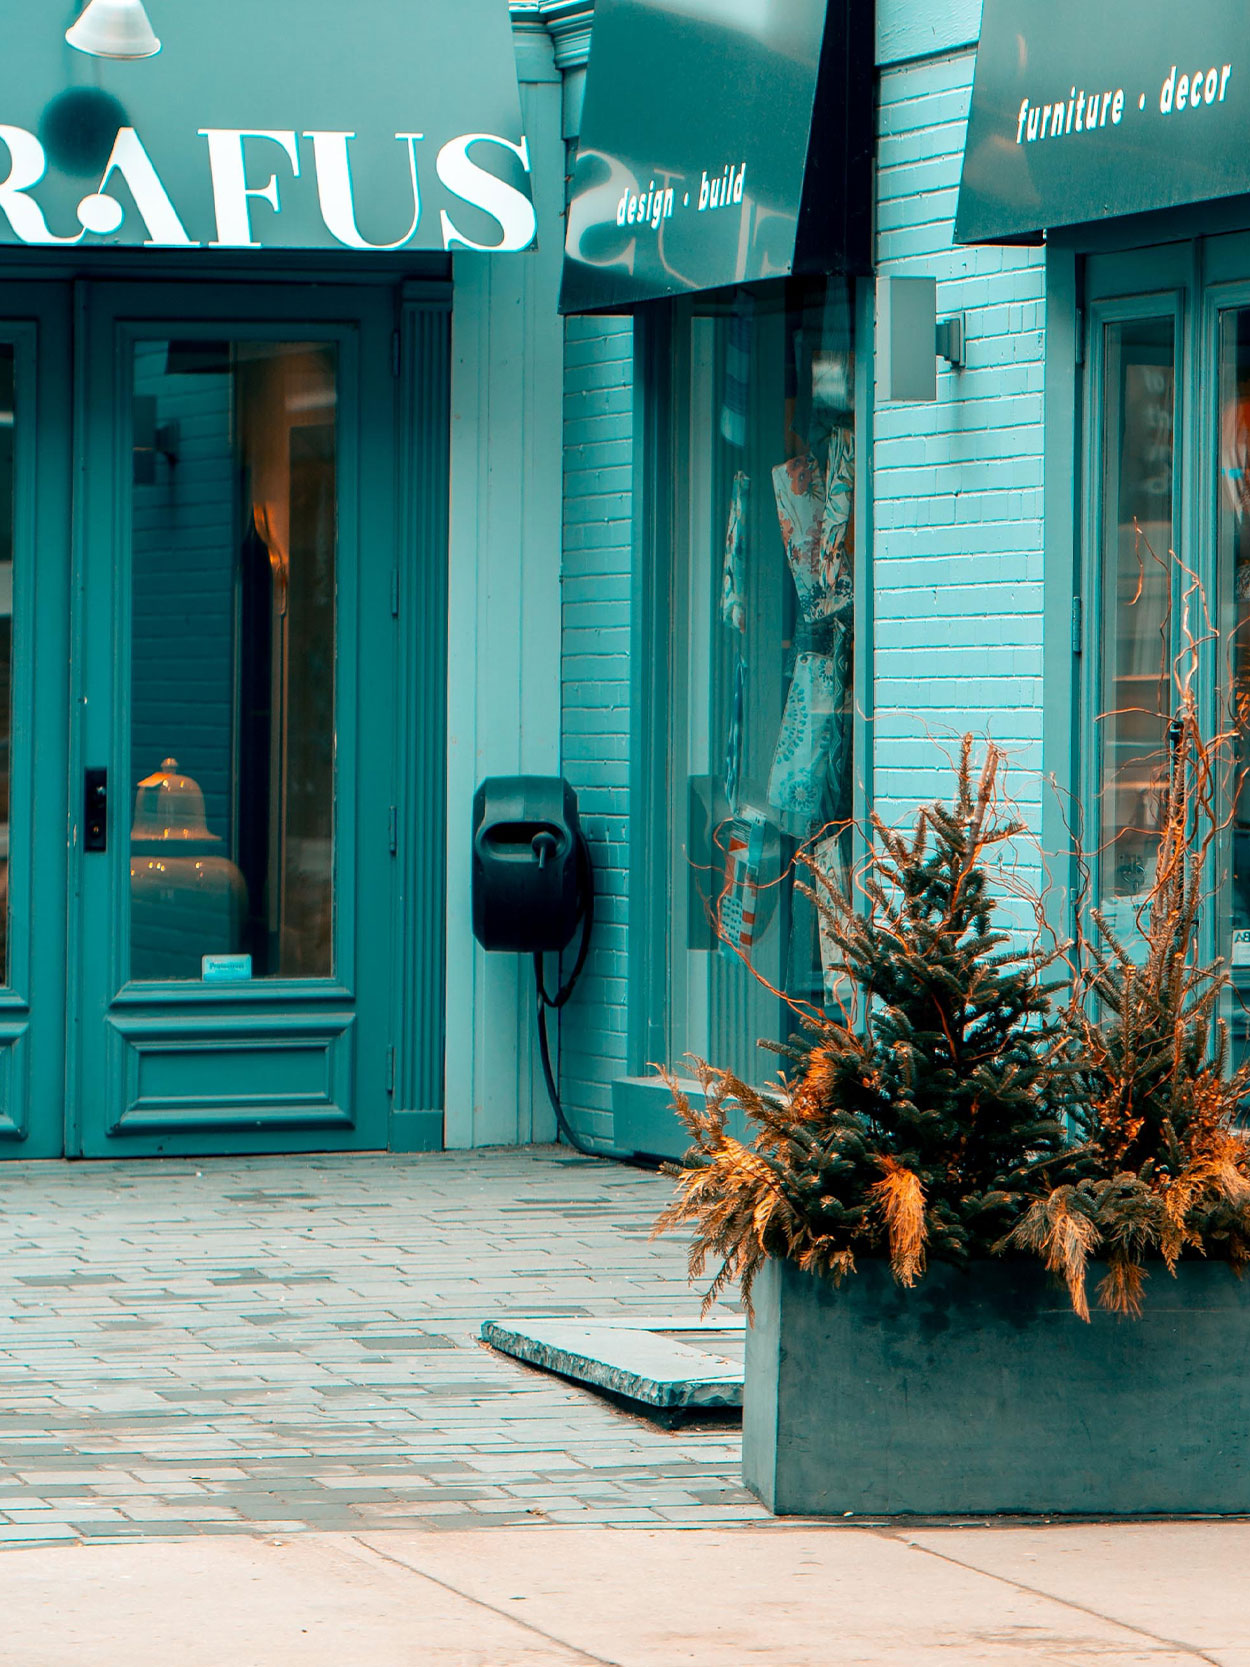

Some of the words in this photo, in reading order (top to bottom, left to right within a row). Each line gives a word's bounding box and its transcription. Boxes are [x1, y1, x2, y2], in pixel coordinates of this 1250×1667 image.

[1016, 86, 1125, 144] furniture
[1159, 64, 1232, 115] decor
[616, 180, 674, 229] design
[698, 162, 746, 211] build
